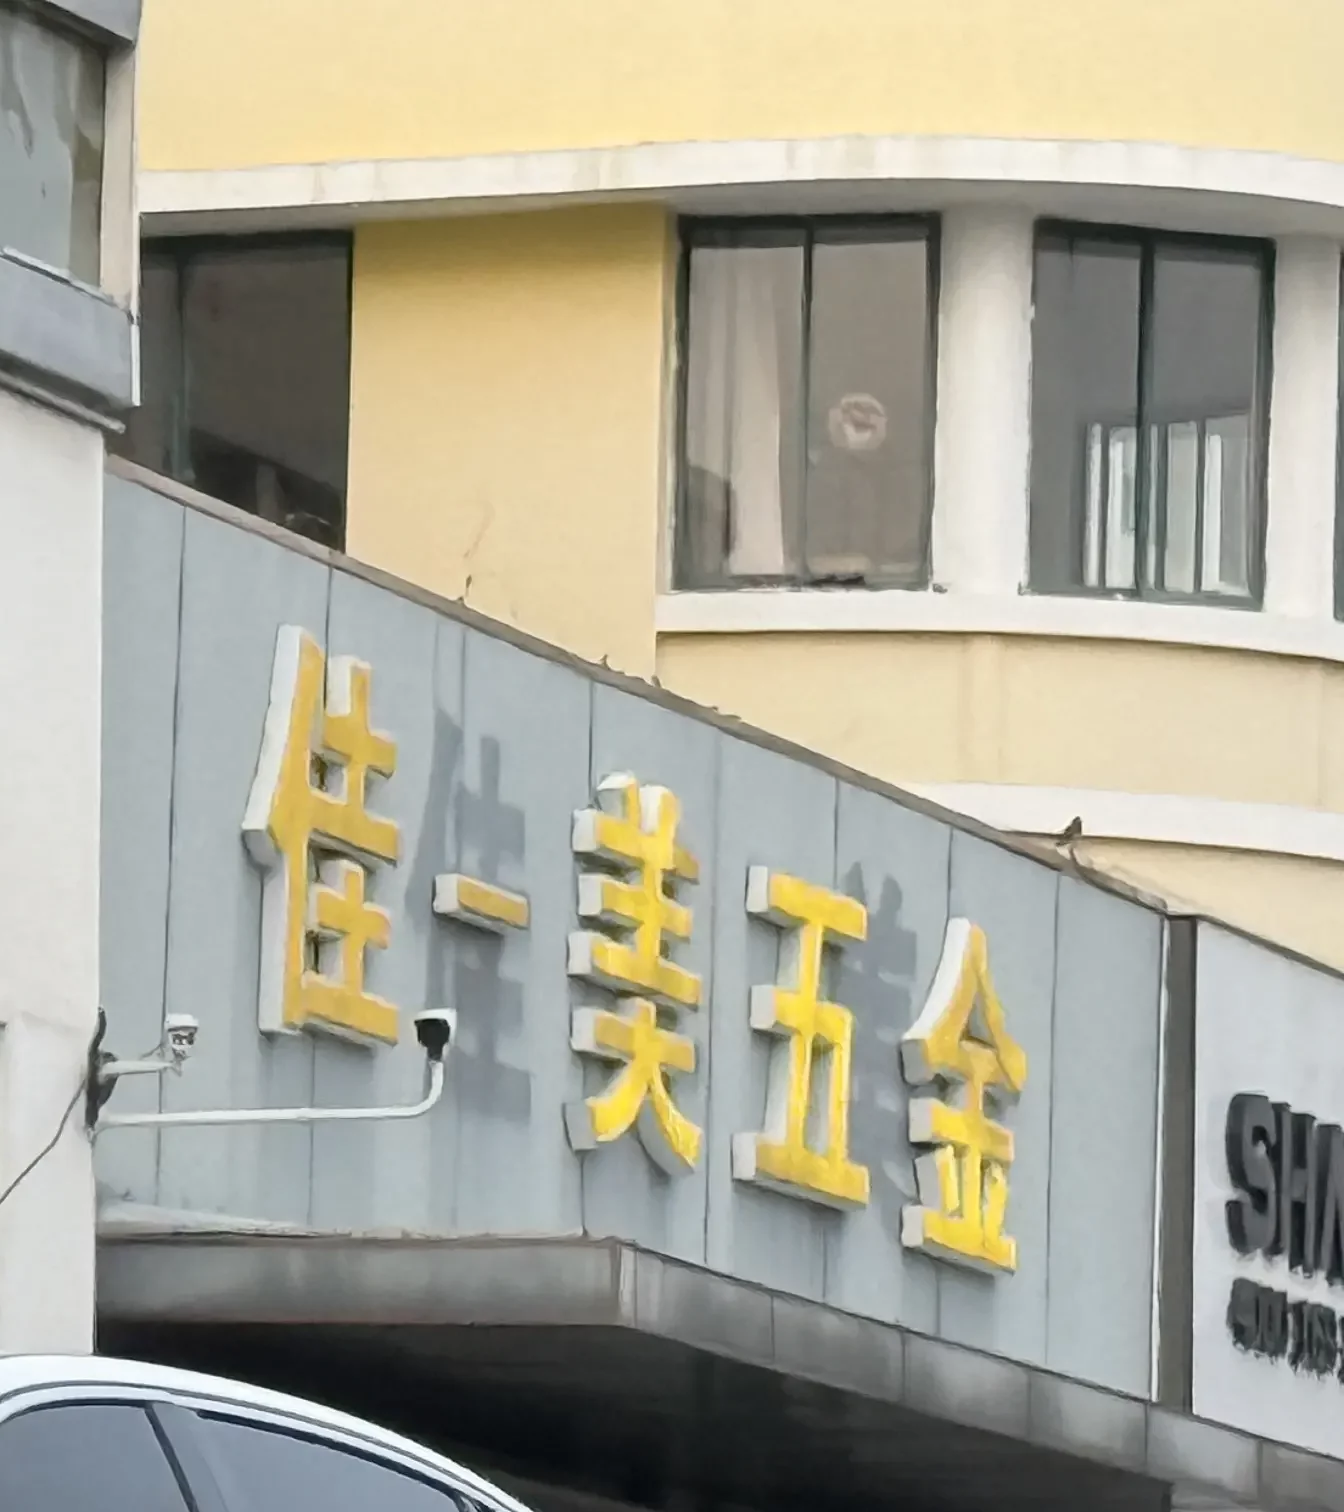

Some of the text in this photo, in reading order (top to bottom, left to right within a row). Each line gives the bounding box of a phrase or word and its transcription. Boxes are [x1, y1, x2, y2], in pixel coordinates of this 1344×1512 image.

[242, 623, 1028, 1275] 佳一美五金
